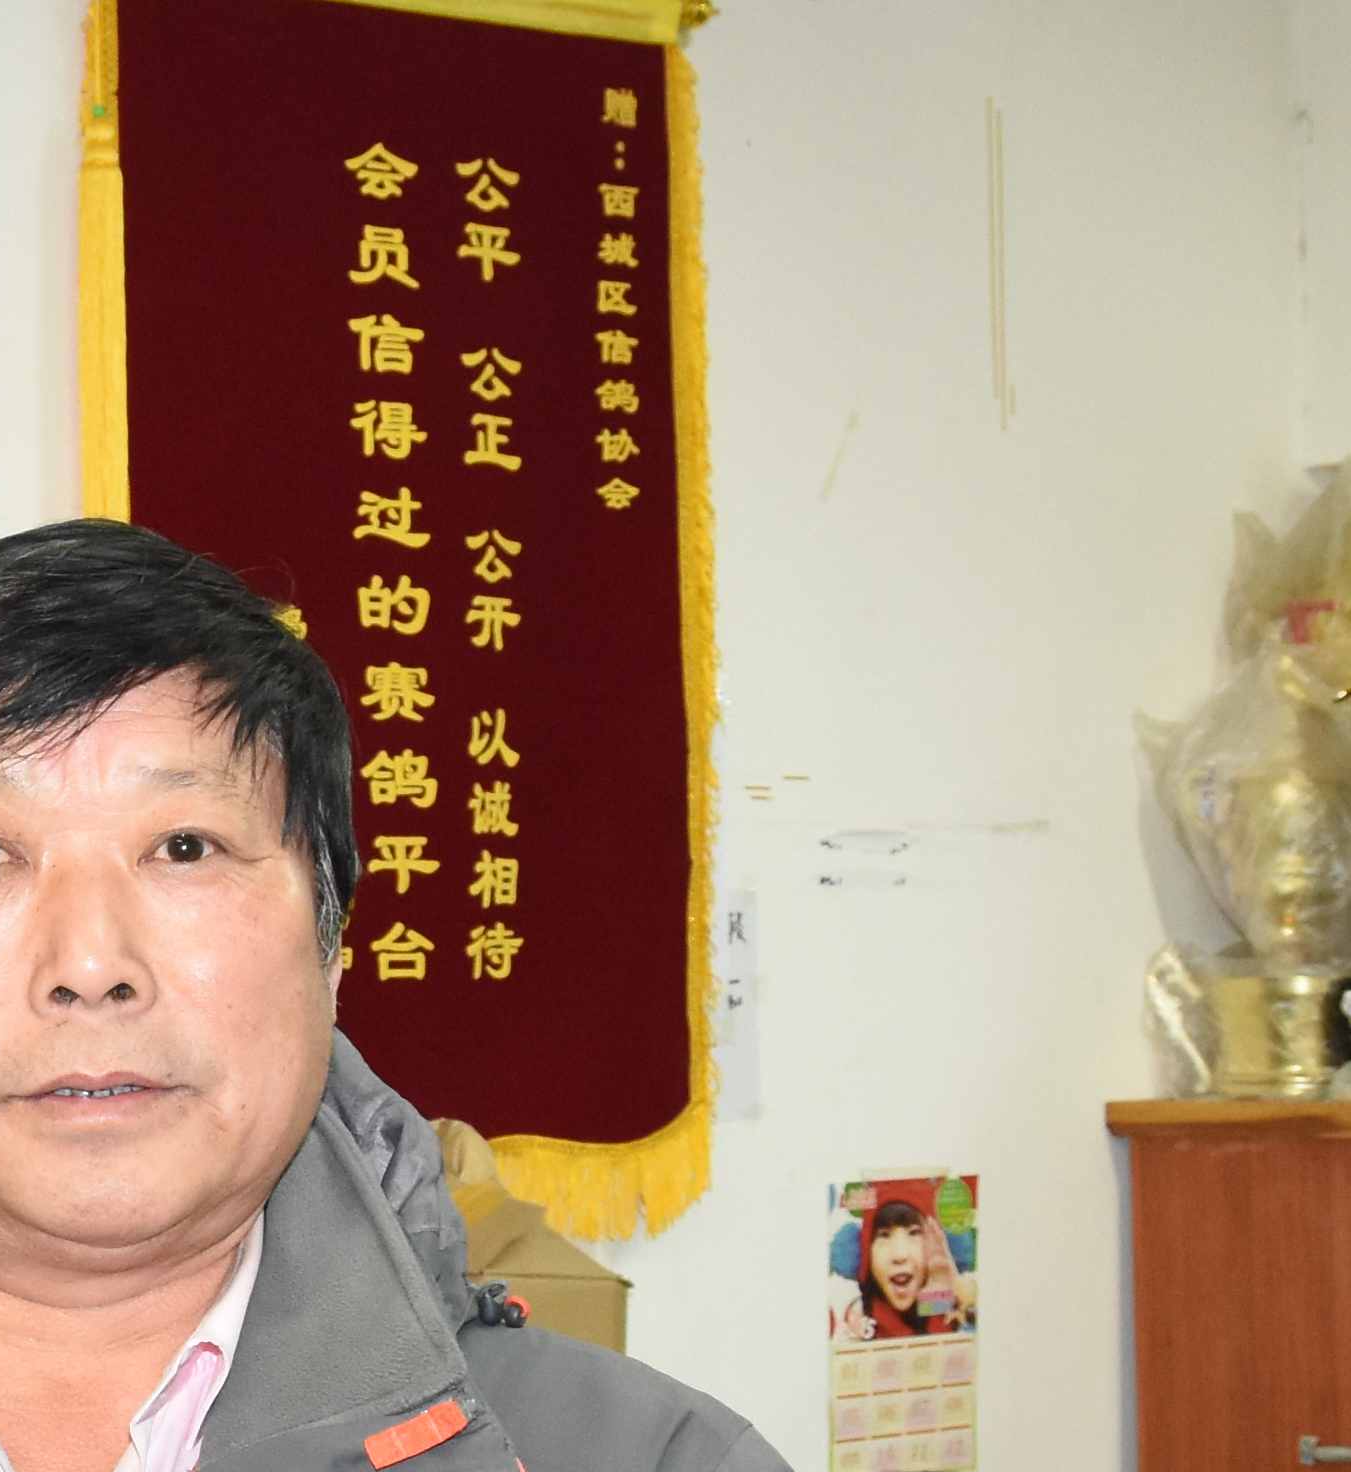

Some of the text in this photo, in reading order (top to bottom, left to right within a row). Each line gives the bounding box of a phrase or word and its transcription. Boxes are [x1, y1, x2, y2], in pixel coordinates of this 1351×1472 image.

[344, 143, 441, 982] 会员信得过的赛鸽平台
[456, 157, 526, 982] 公平 公正 公开 以诚相待
